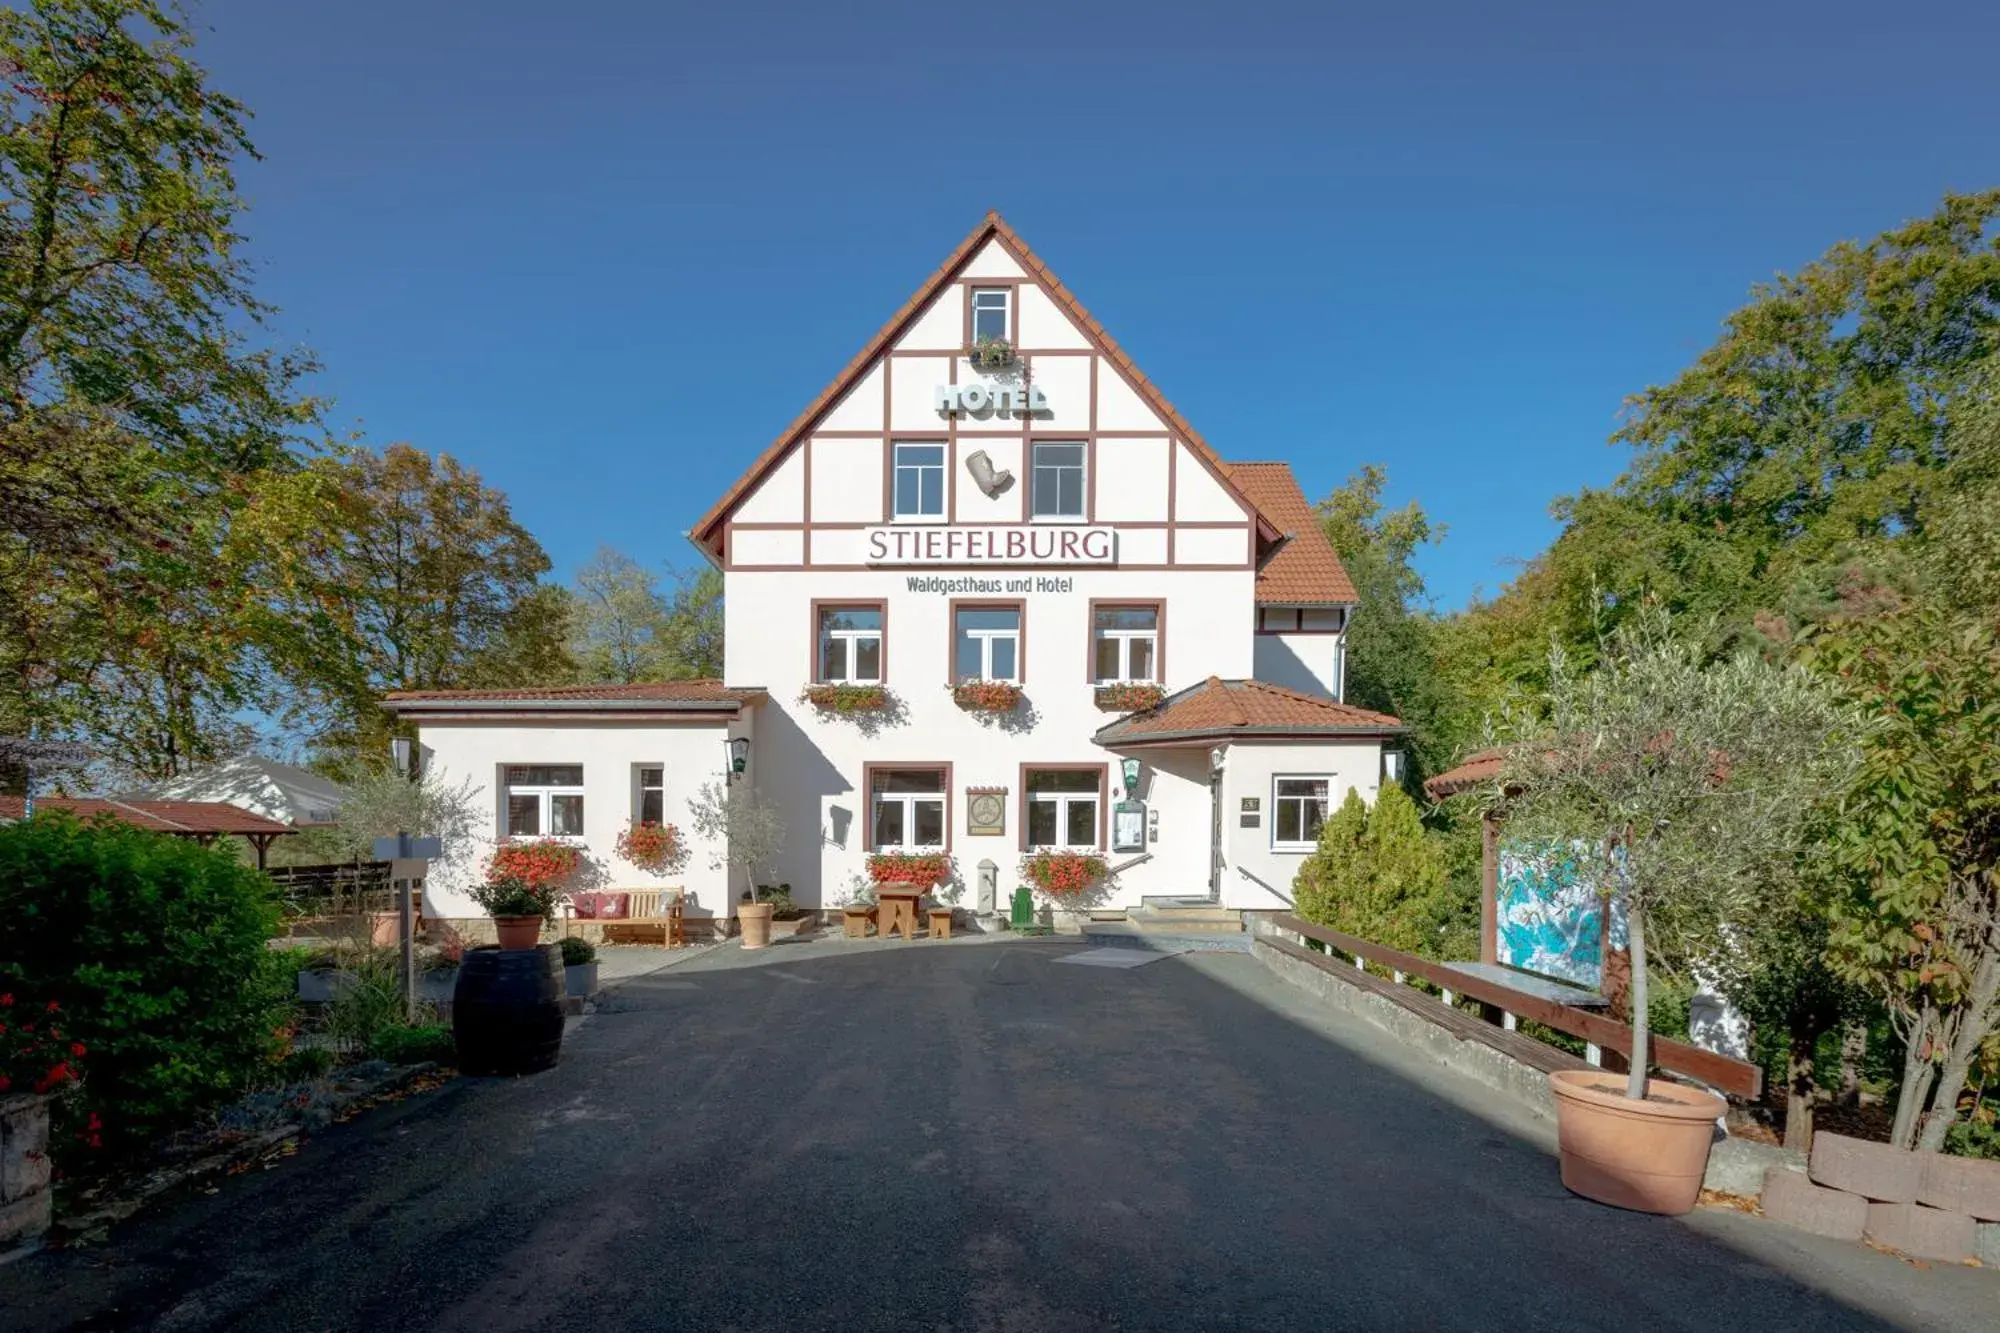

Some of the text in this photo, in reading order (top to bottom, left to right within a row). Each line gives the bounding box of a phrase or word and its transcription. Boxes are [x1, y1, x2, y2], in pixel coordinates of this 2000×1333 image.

[935, 384, 1048, 411] HOTEL
[869, 530, 1109, 559] STIEFELBURG
[906, 576, 1073, 595] Waldgasthaus und Hotel
